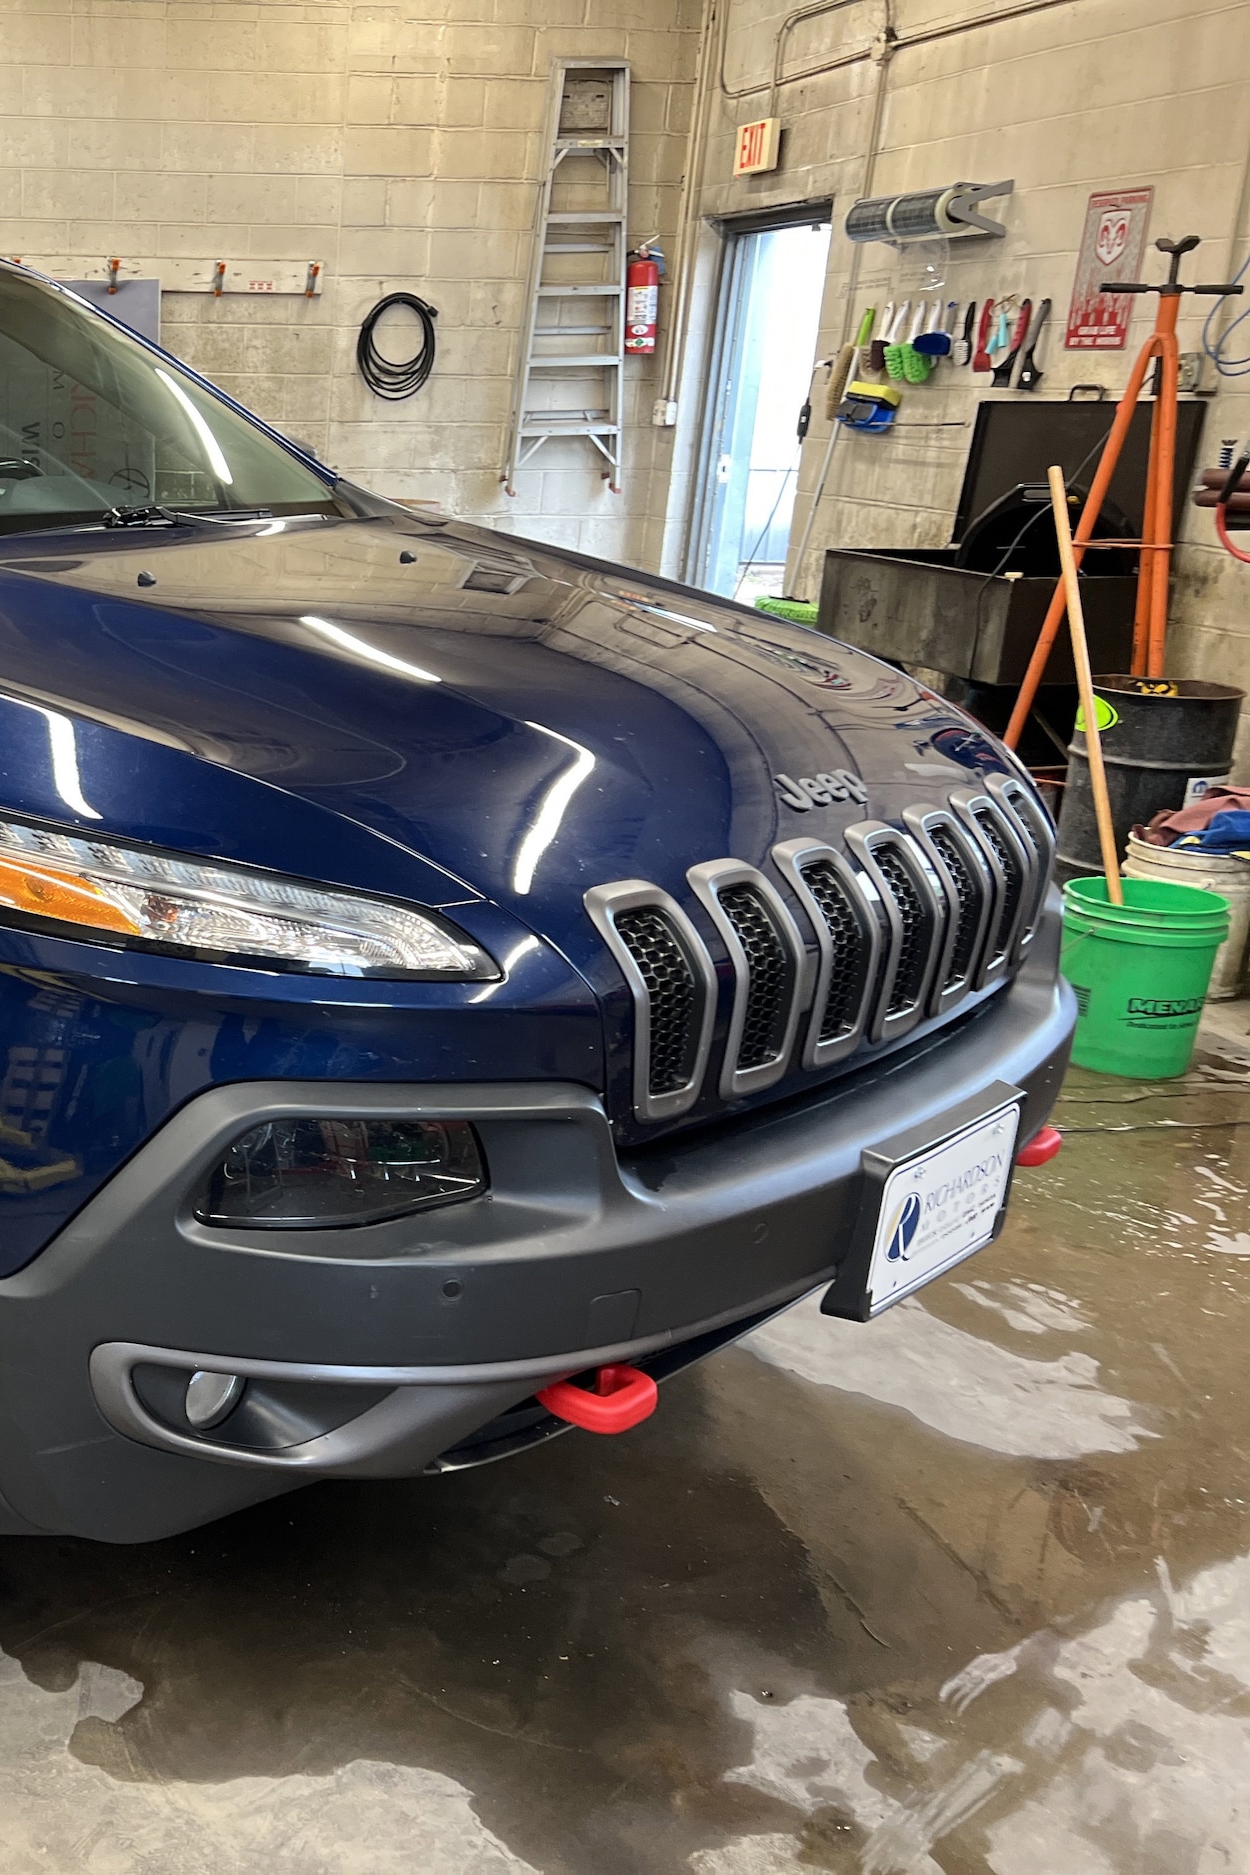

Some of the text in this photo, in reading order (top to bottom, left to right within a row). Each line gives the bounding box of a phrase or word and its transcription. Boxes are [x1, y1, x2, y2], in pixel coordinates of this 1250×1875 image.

[739, 122, 766, 169] EXIT
[772, 768, 869, 813] Jeep
[924, 1149, 1005, 1214] RICHARDSON
